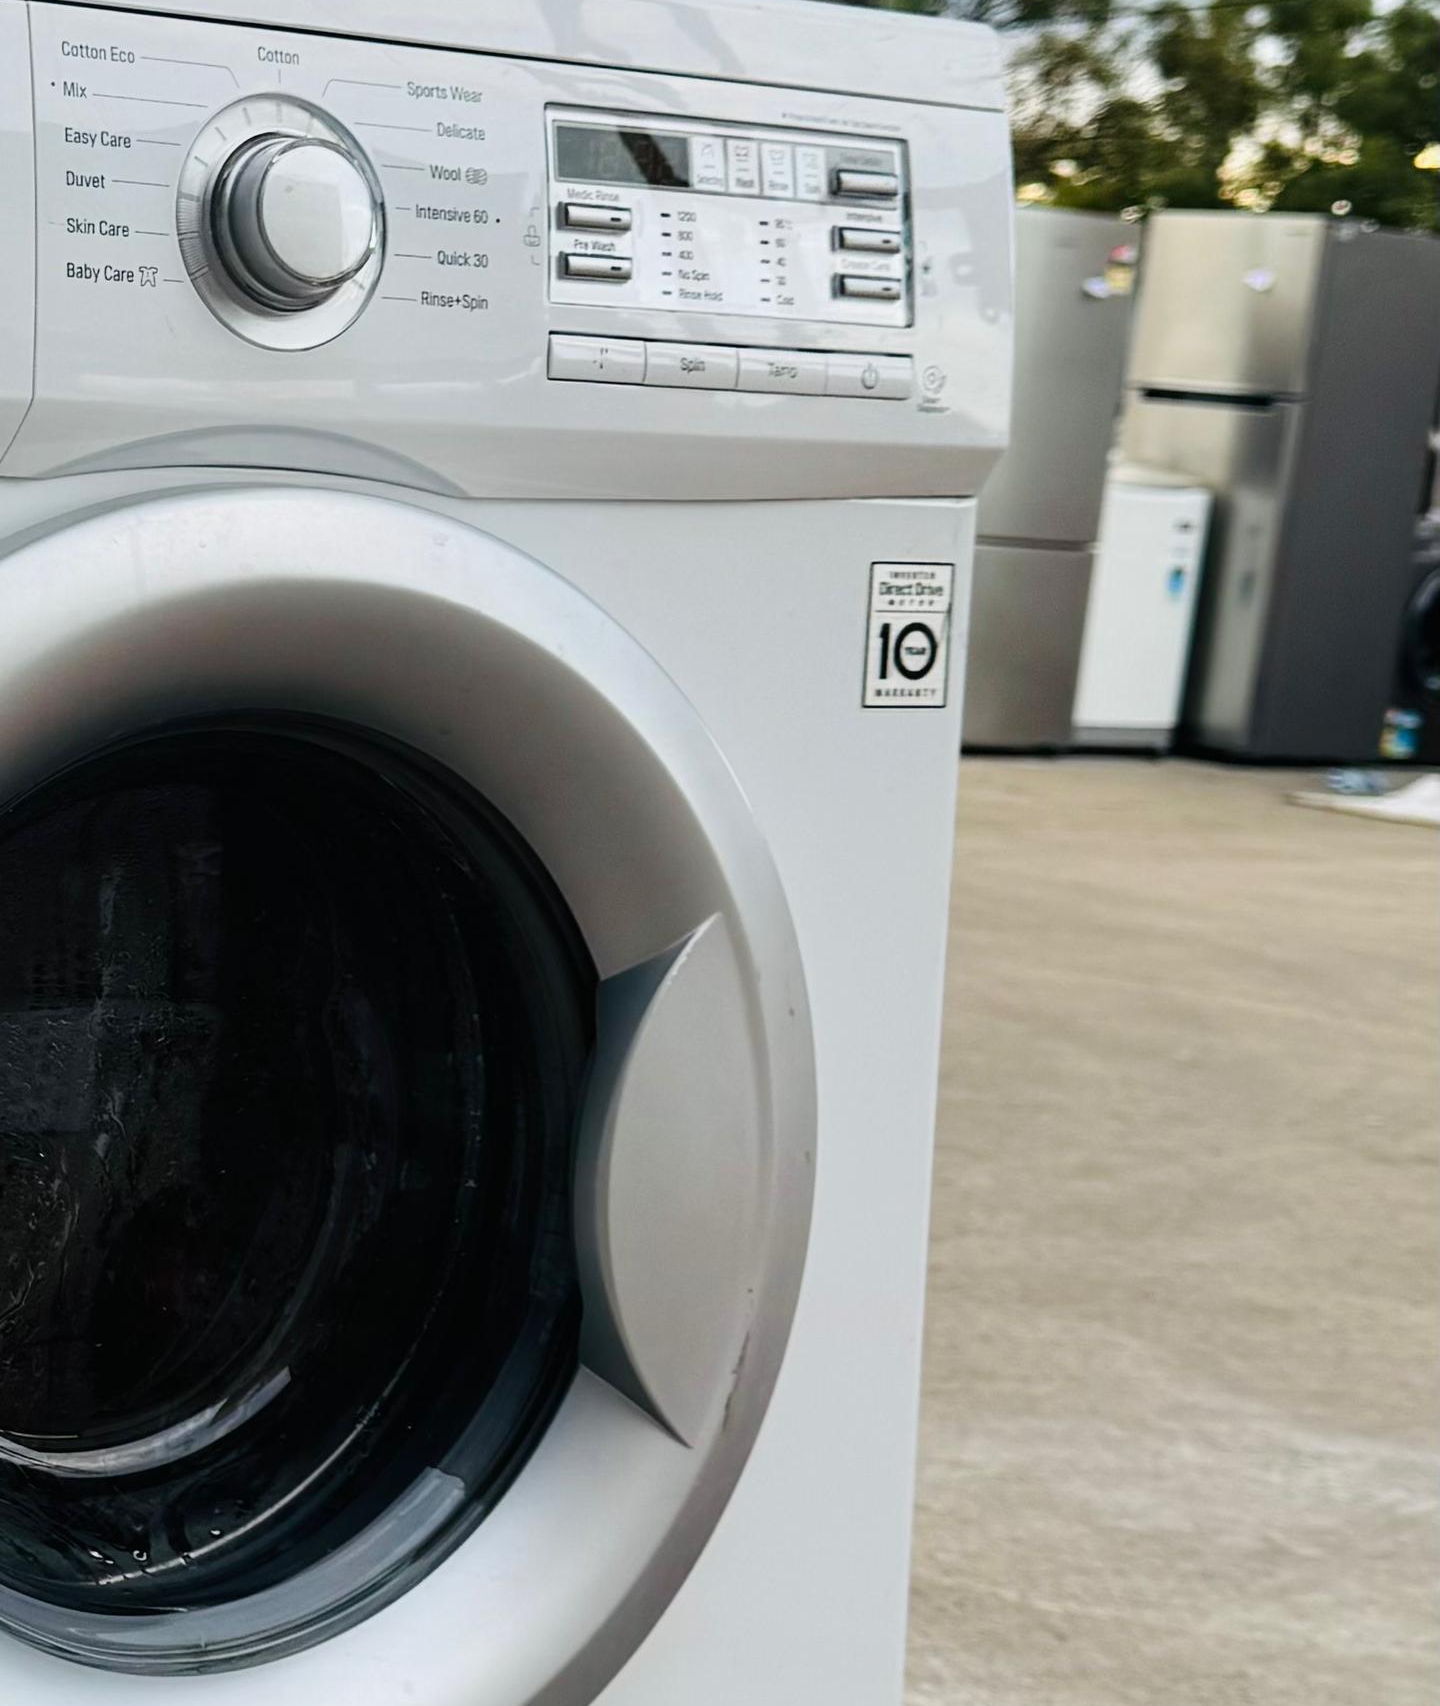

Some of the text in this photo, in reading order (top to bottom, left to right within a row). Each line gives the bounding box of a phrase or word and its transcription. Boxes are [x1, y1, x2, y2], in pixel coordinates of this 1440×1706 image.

[61, 41, 135, 64] Cotton Eco
[257, 46, 300, 65] Cotton
[63, 81, 87, 98] Mix
[406, 82, 483, 103] Sports Wear
[64, 127, 132, 149] Easy Care
[436, 122, 486, 141] Delicate
[65, 170, 106, 189] Duvet
[429, 164, 462, 182] Wool
[415, 203, 489, 224] Intensive 60
[66, 217, 130, 238] Skin Care
[437, 251, 489, 269] Quick 30
[66, 262, 135, 284] Baby Care
[420, 291, 489, 311] Rinse+Spin
[680, 357, 706, 374] Spin
[915, 582, 944, 597] Drive
[879, 622, 938, 680] 10
